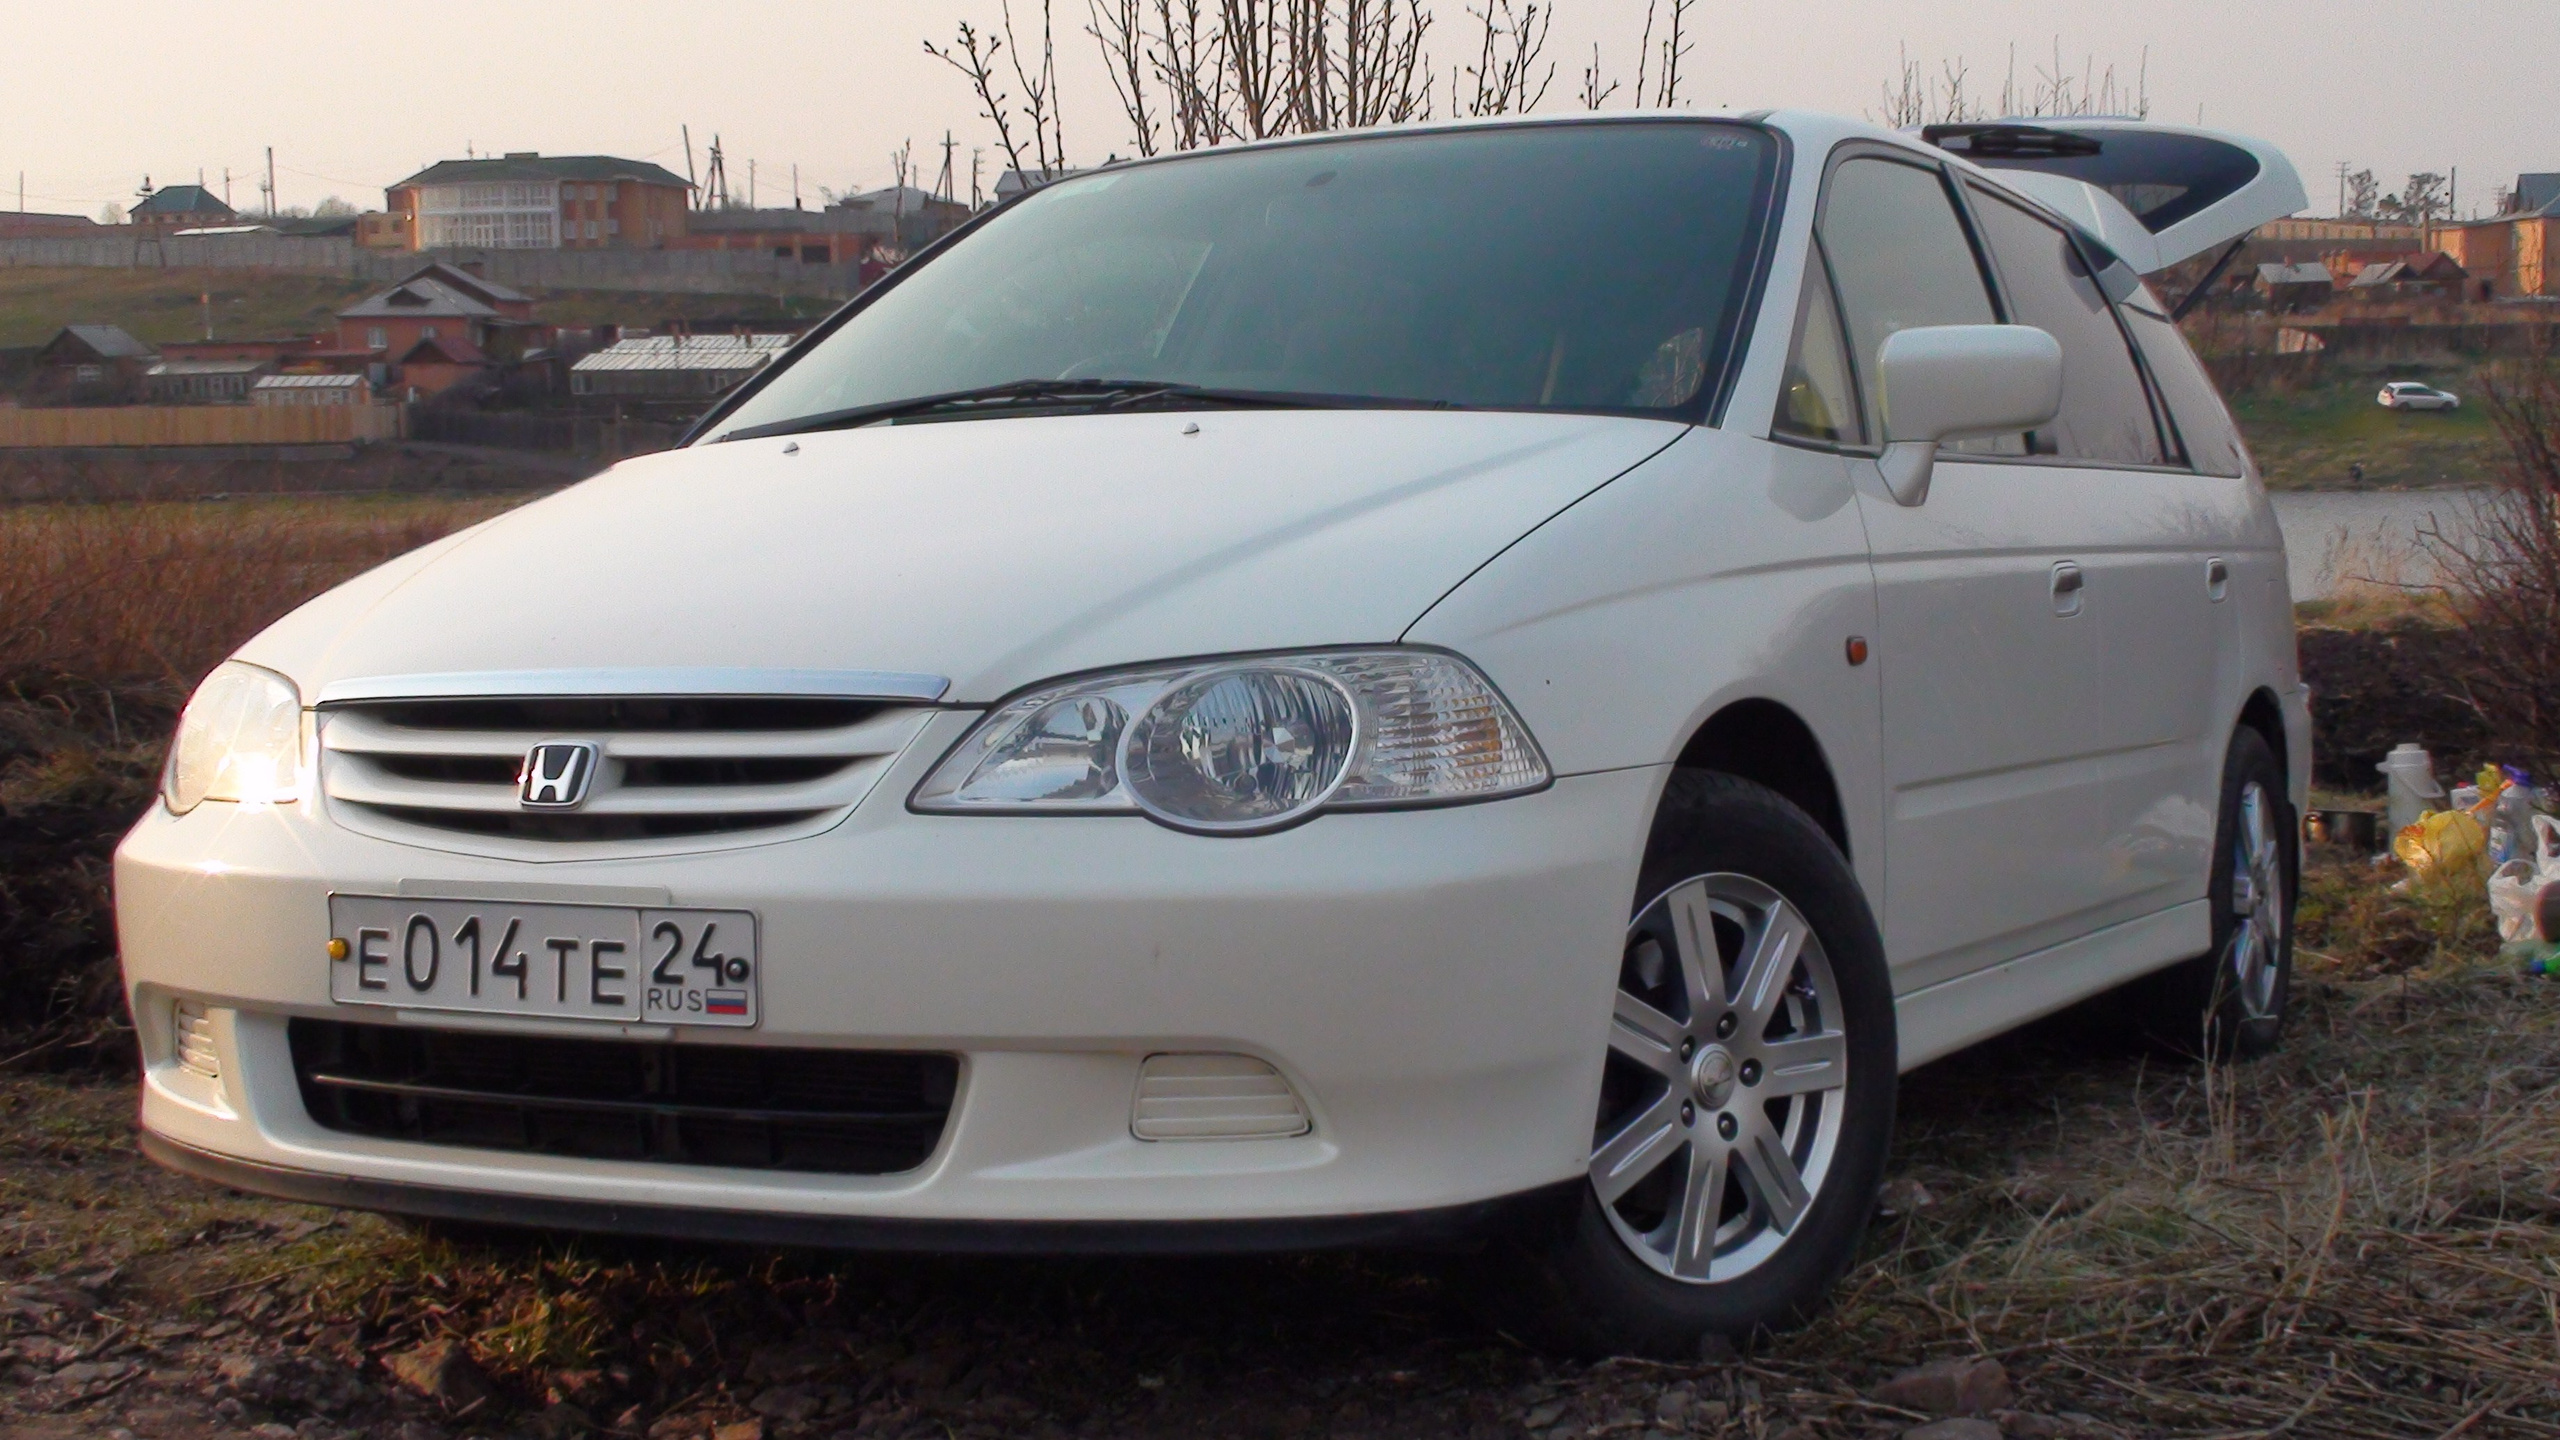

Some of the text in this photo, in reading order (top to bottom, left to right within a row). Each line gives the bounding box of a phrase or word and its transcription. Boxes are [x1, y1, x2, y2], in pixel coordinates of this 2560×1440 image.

[358, 912, 725, 1006] E014TE 24
[647, 988, 703, 1012] RUS
